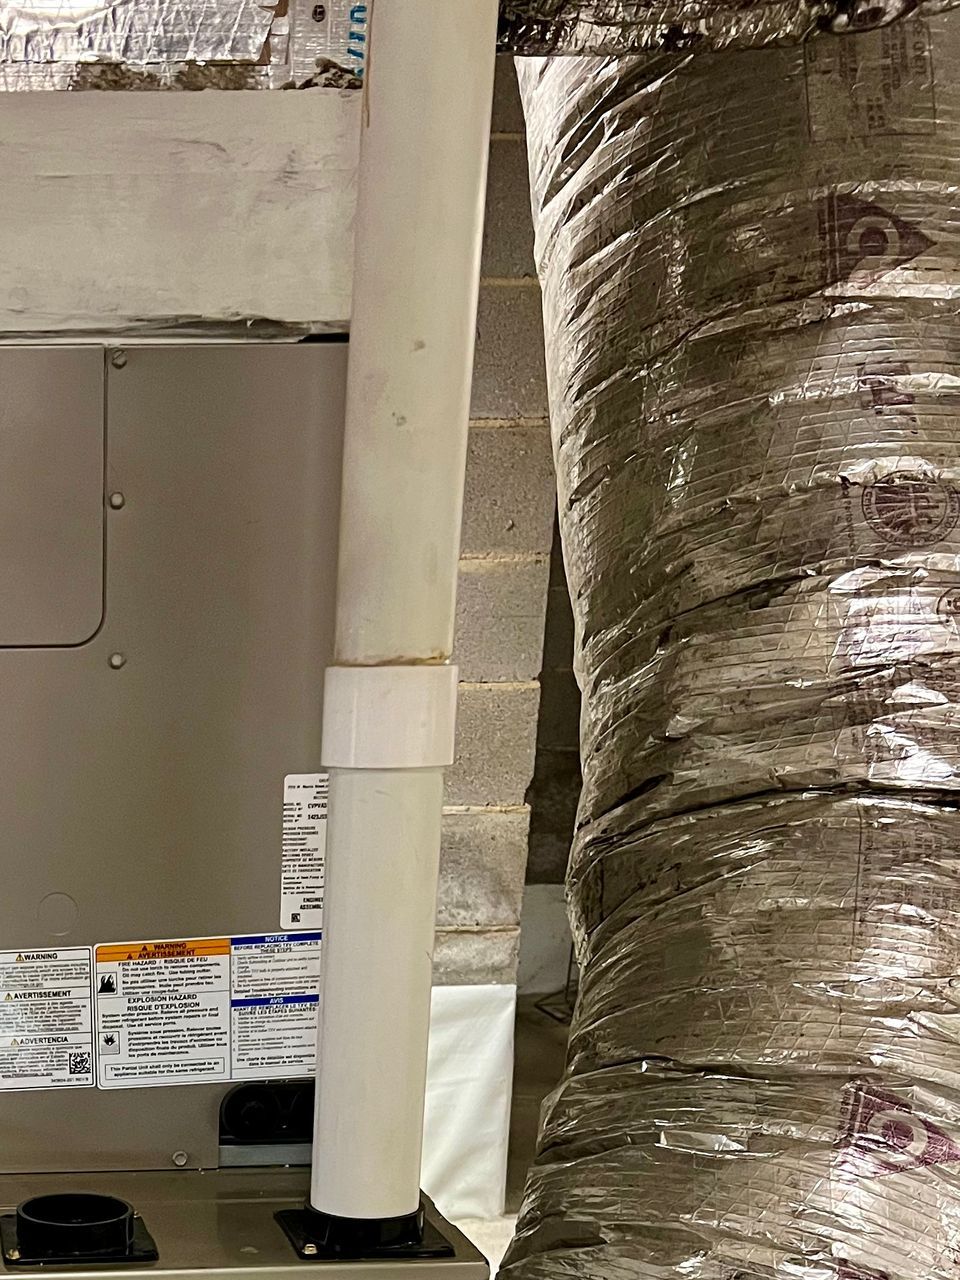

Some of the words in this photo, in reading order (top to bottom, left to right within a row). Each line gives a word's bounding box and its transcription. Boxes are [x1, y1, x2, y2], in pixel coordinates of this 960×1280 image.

[138, 950, 195, 959] AVERTISSEMENT
[14, 990, 72, 1000] AVERTISSEMENT
[128, 996, 167, 1004] EXPLOSION
